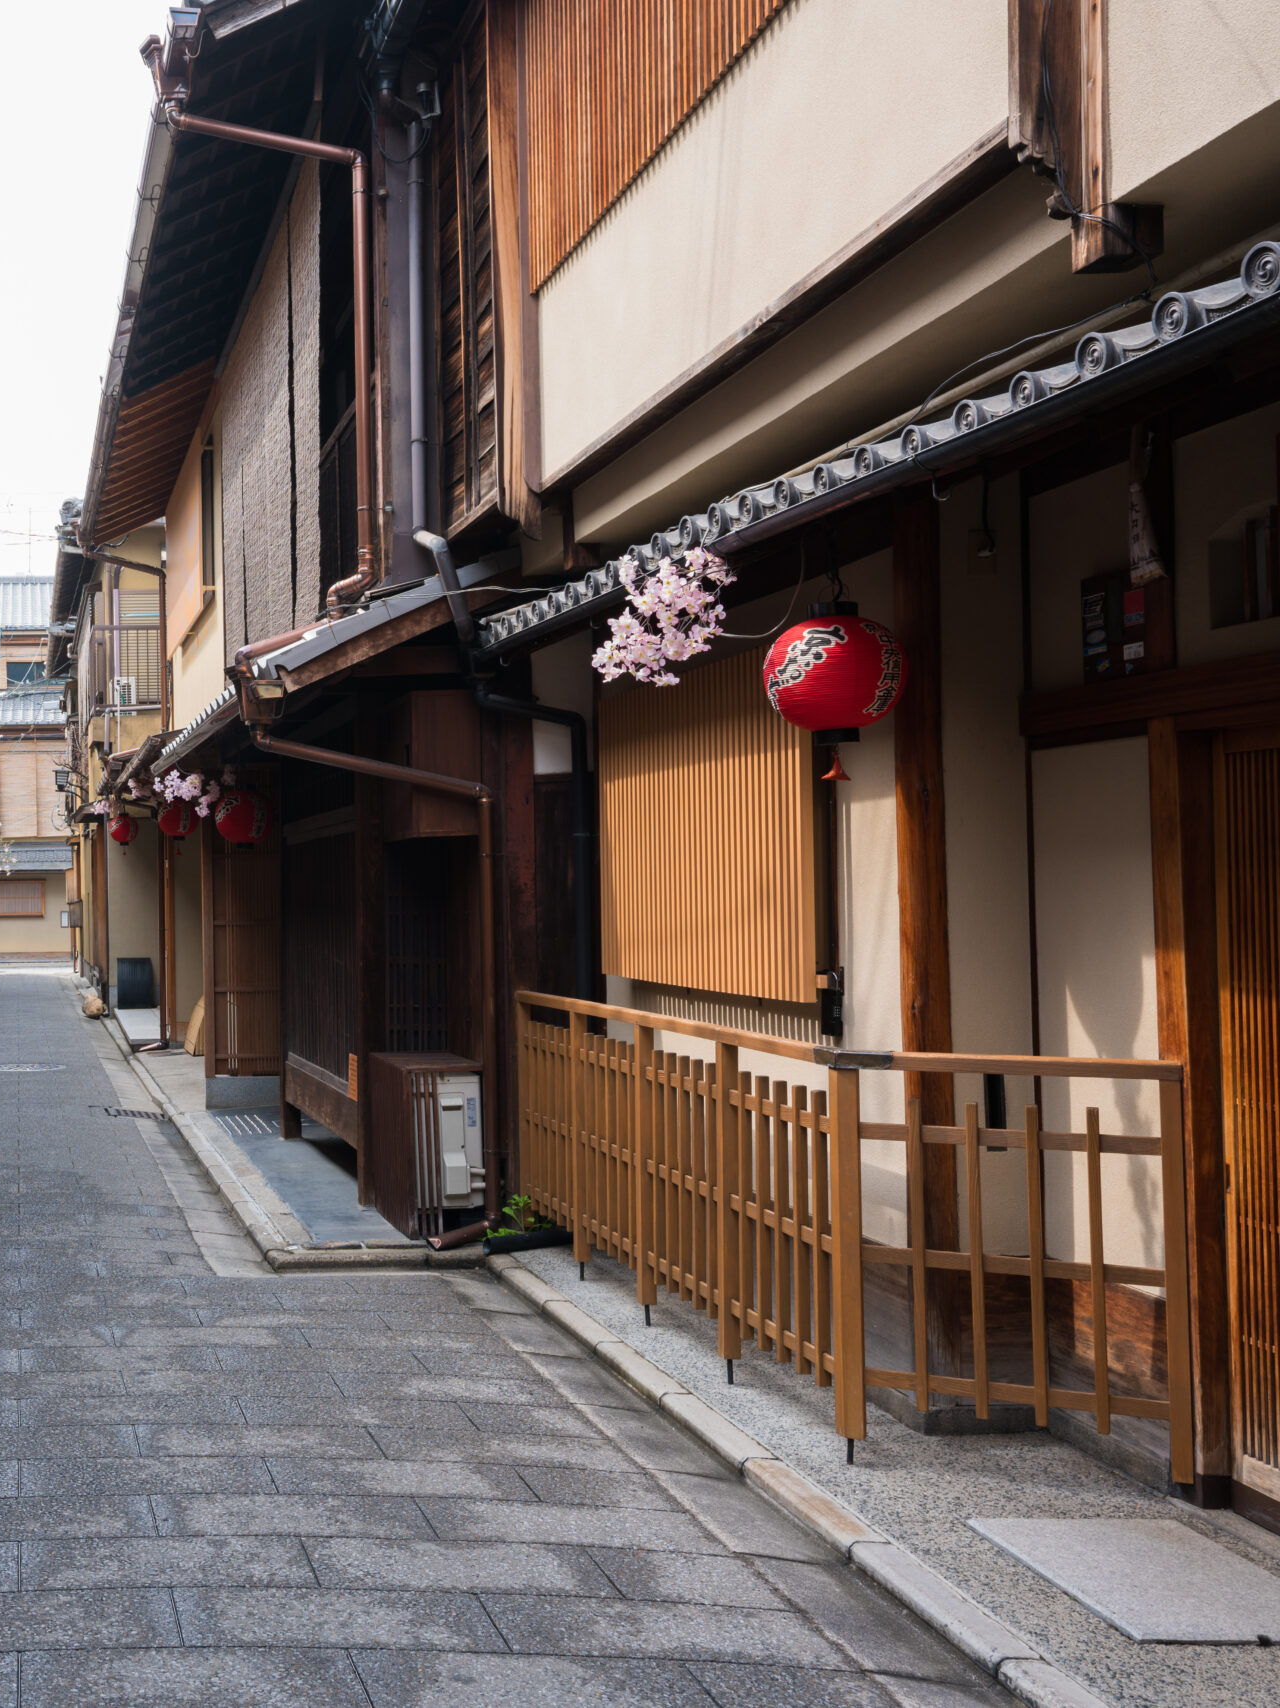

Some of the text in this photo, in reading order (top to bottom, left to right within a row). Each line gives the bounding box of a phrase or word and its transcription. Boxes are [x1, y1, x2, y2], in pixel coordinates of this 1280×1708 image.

[862, 632, 902, 717] 中央信用金庫
